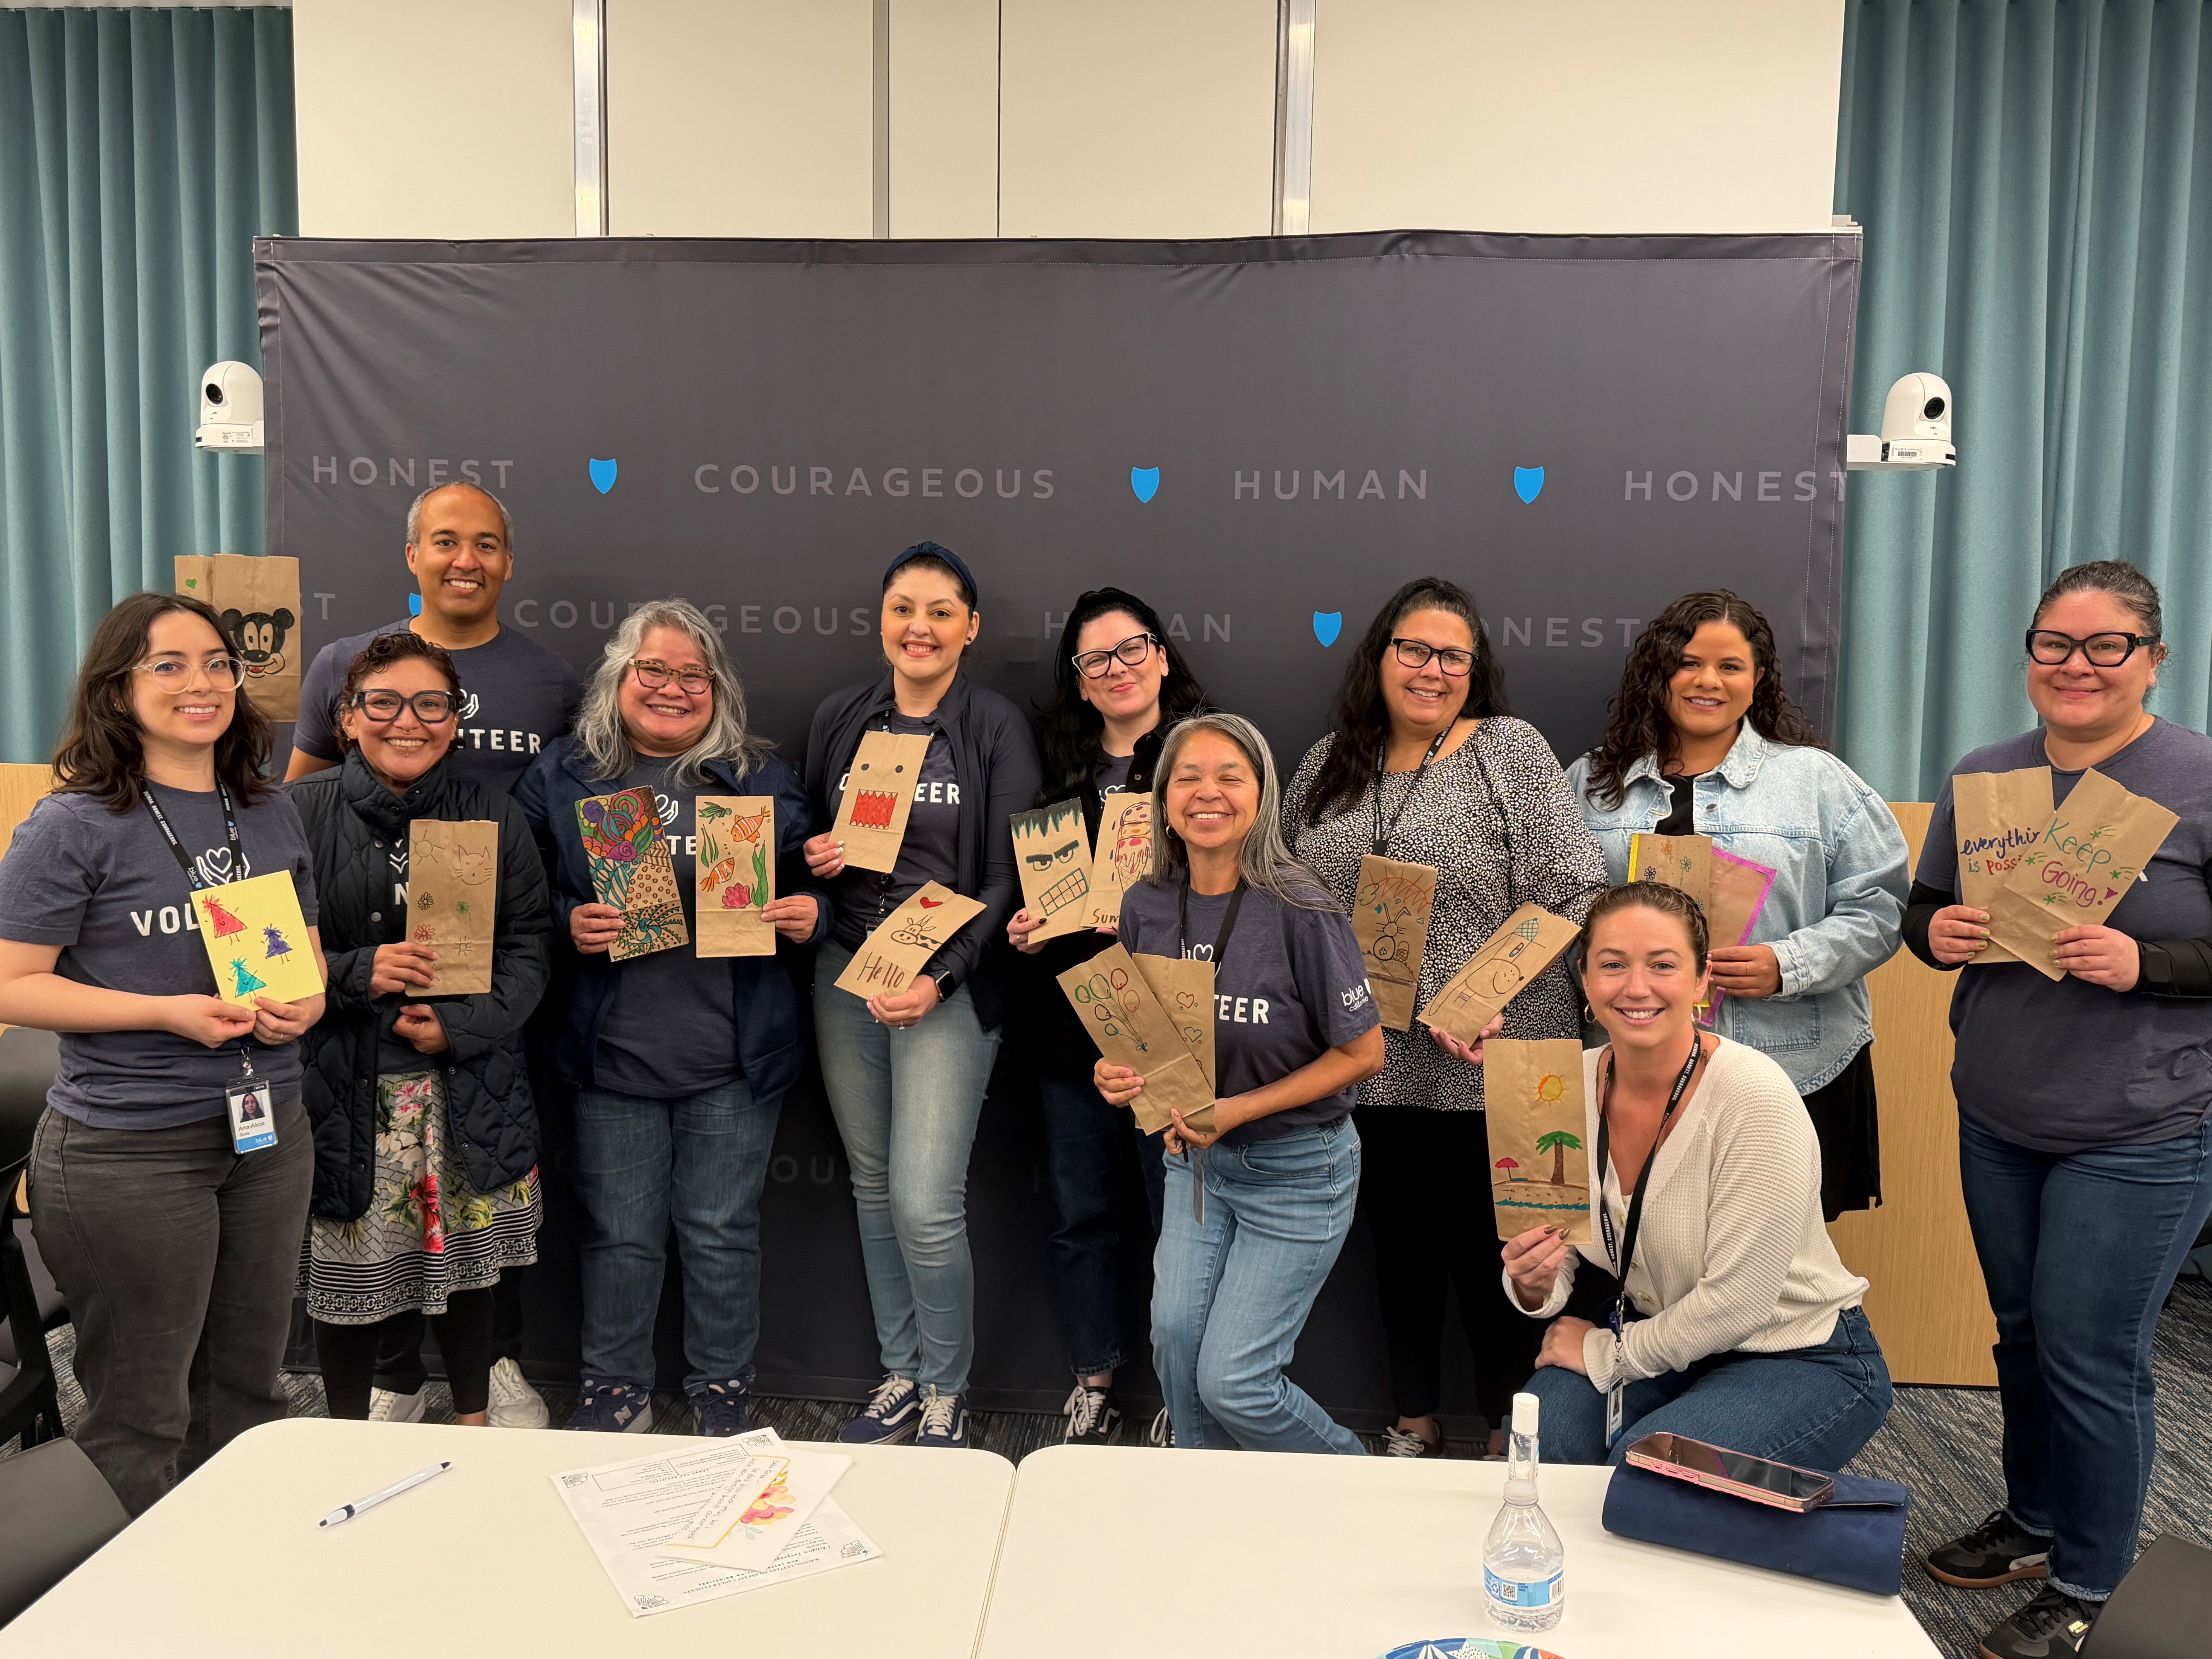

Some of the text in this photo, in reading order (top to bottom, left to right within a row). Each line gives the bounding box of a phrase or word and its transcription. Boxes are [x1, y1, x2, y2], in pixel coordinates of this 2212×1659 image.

[313, 455, 513, 489] HONEST
[694, 464, 1054, 500] COURAGEOUS
[1234, 469, 1427, 500] HUMAN
[1624, 470, 1846, 502] HONEST
[514, 599, 871, 637] COUGEOUS
[1044, 611, 1231, 642] HAN
[1476, 617, 1640, 648] ONEST
[2043, 817, 2111, 873] Keep
[1968, 858, 1980, 873] is
[856, 951, 905, 988] Hello
[1341, 985, 1364, 1006] blue
[1684, 1058, 1695, 1075] HONEST.
[1671, 1075, 1687, 1101] COURAGEOUS.
